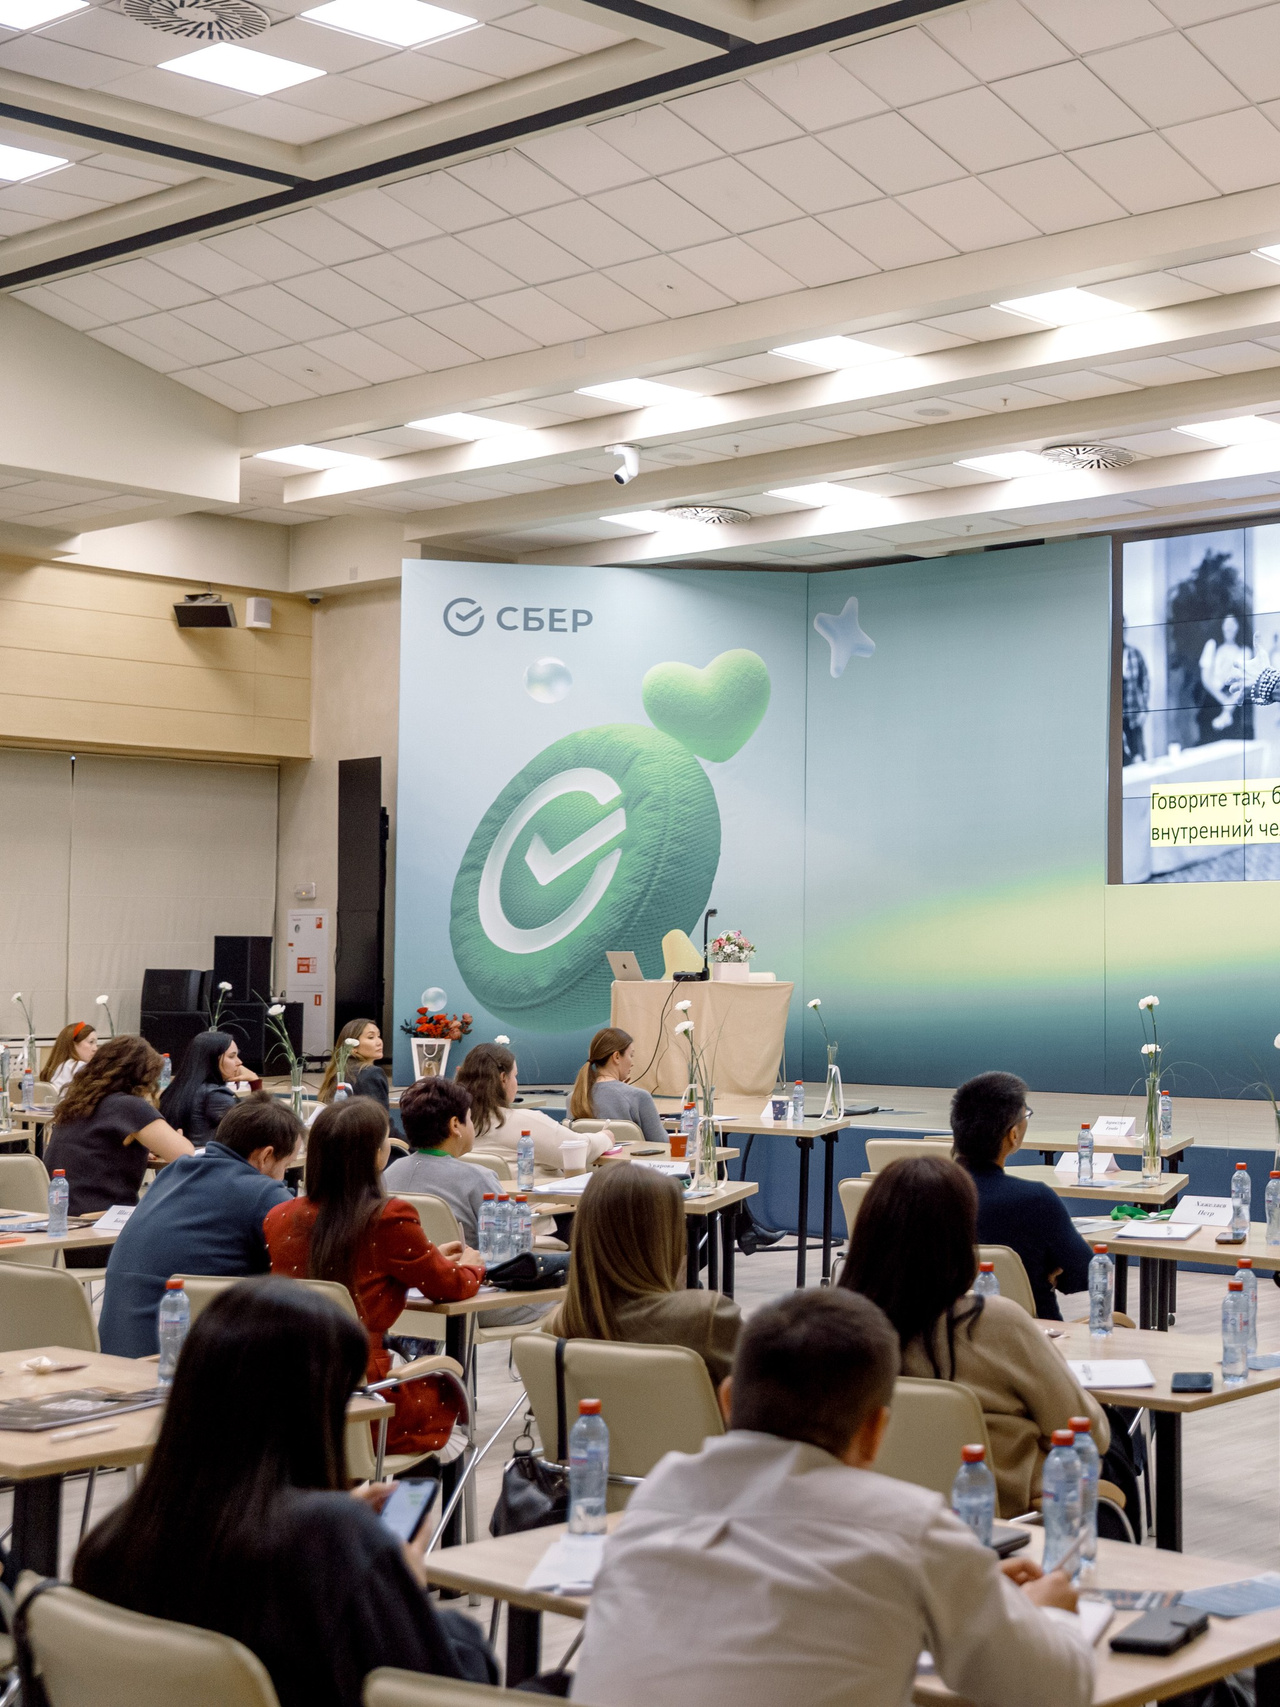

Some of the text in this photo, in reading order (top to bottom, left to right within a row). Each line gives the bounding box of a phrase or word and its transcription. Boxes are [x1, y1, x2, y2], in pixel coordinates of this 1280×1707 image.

[496, 606, 594, 633] СБЕР
[1151, 792, 1228, 813] Говорите
[1233, 791, 1266, 808] так,
[1151, 818, 1254, 844] внутренний
